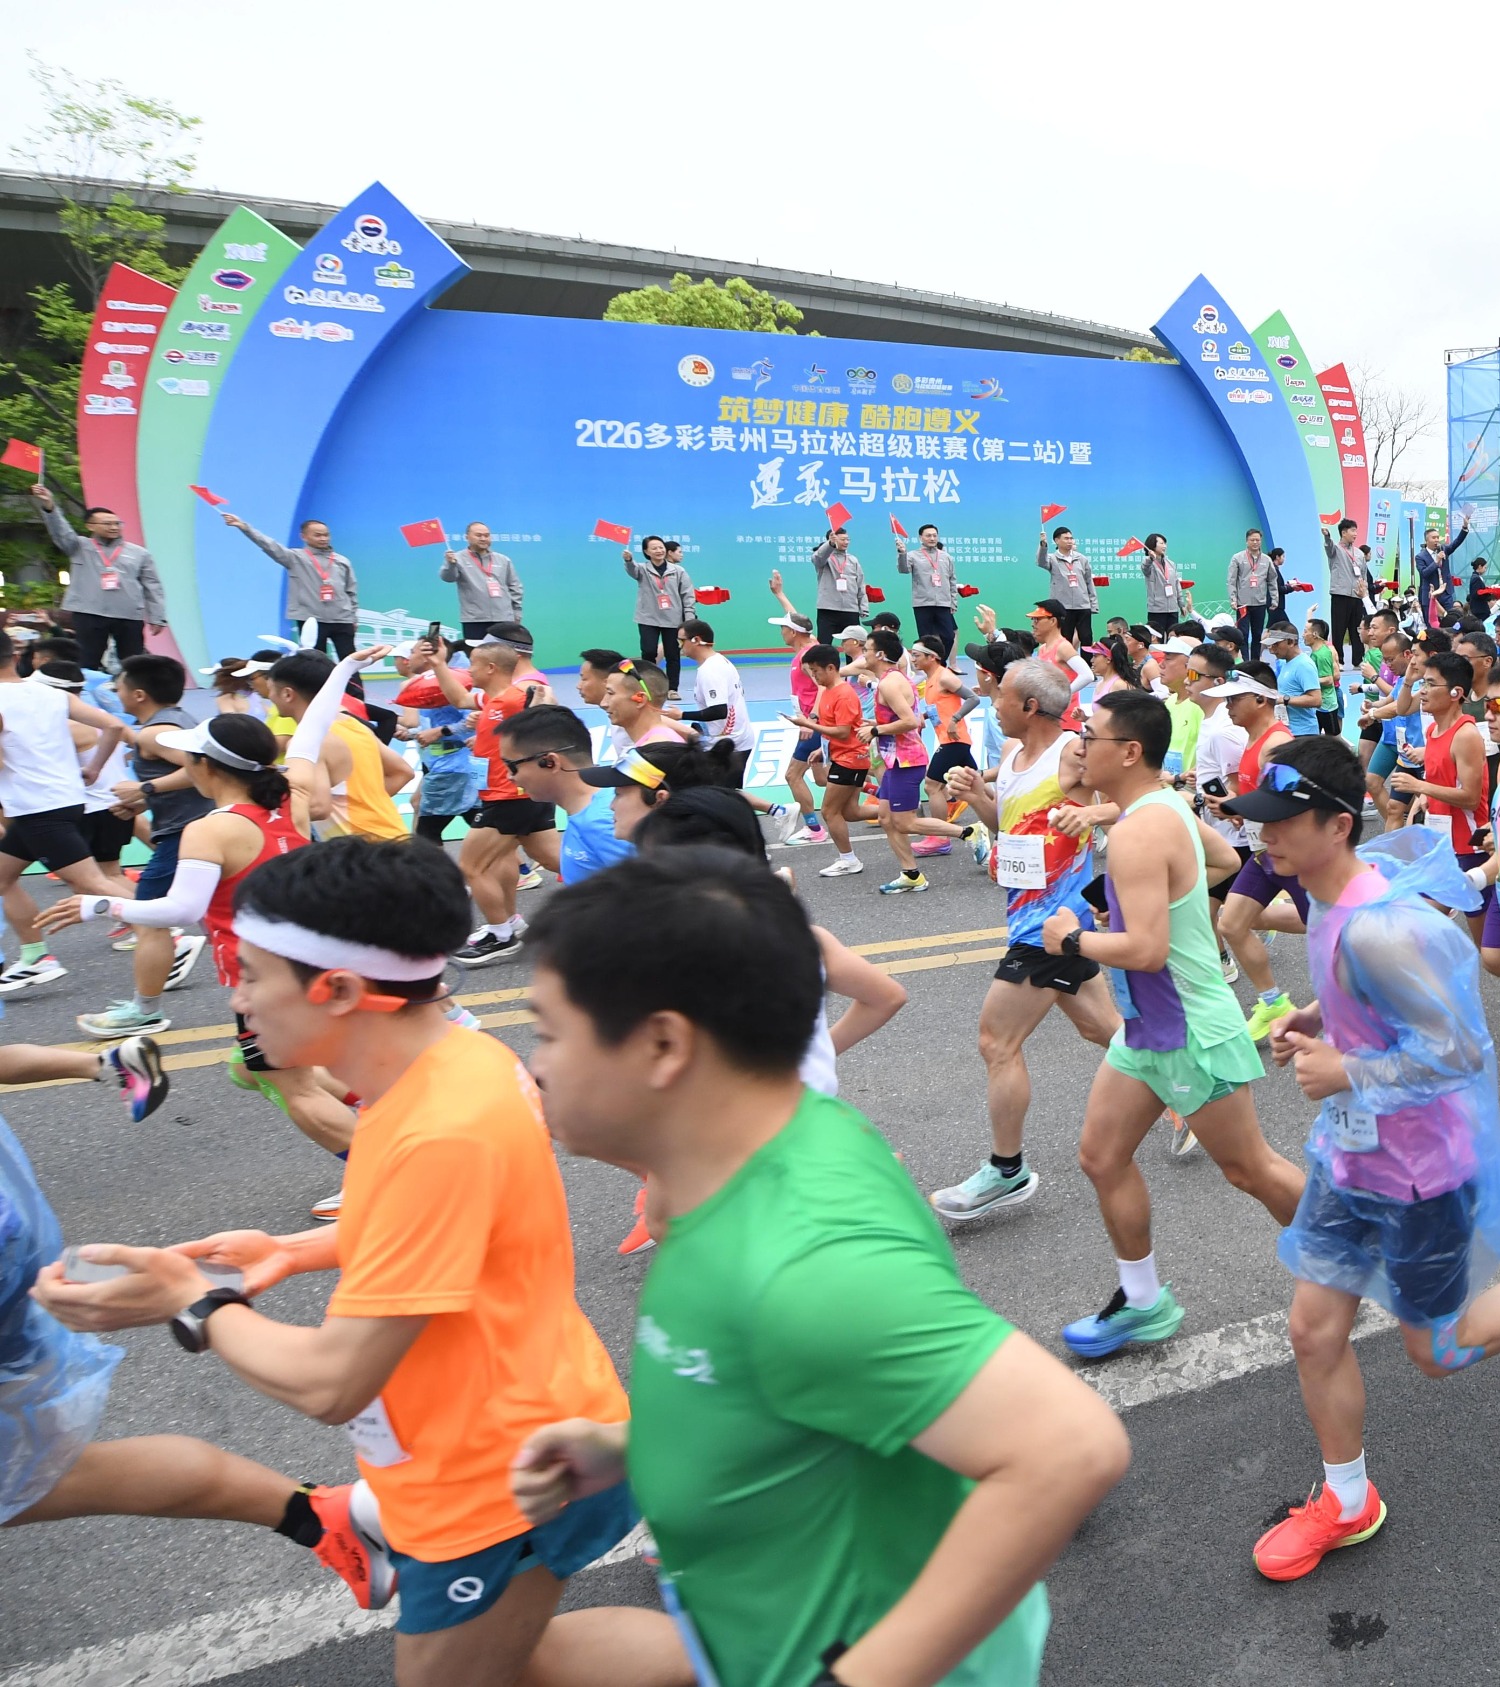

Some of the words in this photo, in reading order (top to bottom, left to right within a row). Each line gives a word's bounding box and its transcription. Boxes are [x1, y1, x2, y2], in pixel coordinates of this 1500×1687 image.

[914, 376, 943, 386] 多彩贵州
[717, 396, 850, 428] 筑梦健康
[861, 404, 981, 434] 酷跑遵义
[575, 419, 1092, 466] 2026多彩贵州马拉松超级联赛(第二站)暨
